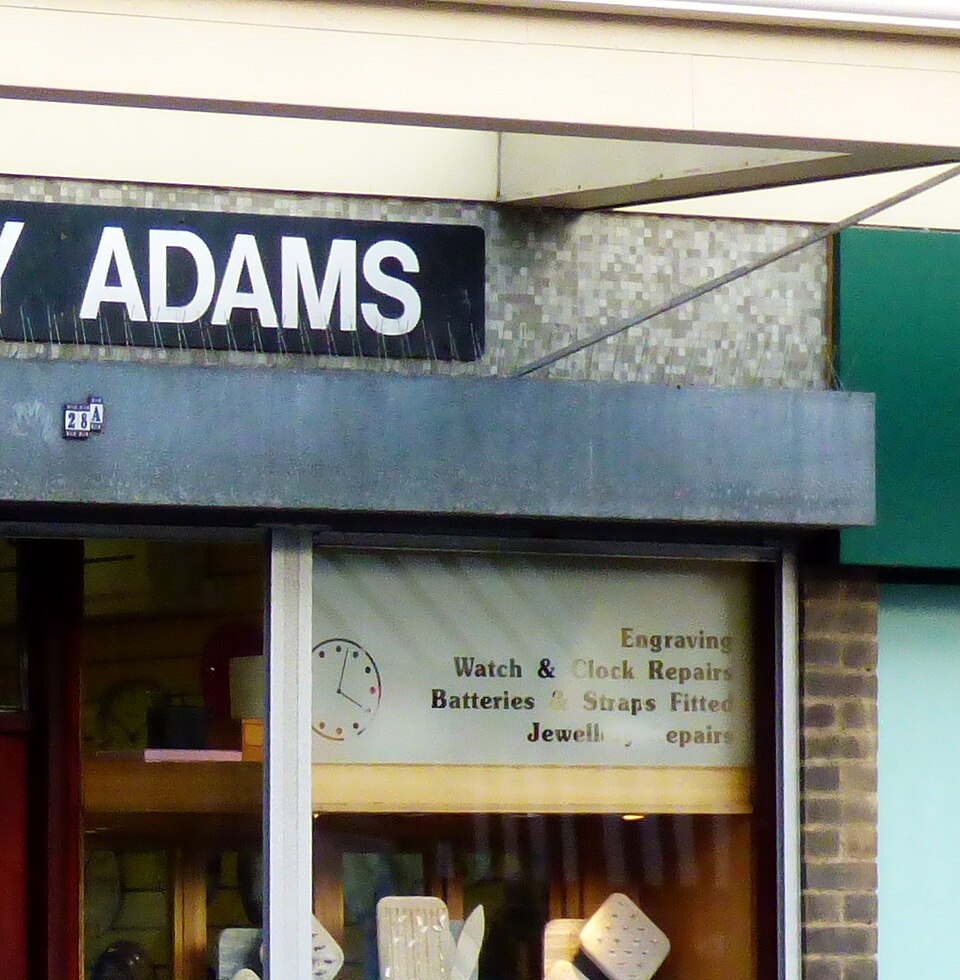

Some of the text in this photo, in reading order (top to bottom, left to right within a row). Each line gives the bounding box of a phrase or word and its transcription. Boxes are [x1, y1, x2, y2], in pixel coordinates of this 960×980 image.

[79, 226, 422, 336] ADAMS
[67, 406, 102, 430] 28A
[621, 627, 734, 655] Engraving
[453, 656, 734, 685] Watch & Clock Repairs
[431, 688, 536, 710] Batteries
[583, 690, 657, 716] Straps
[670, 691, 734, 713] Fitted
